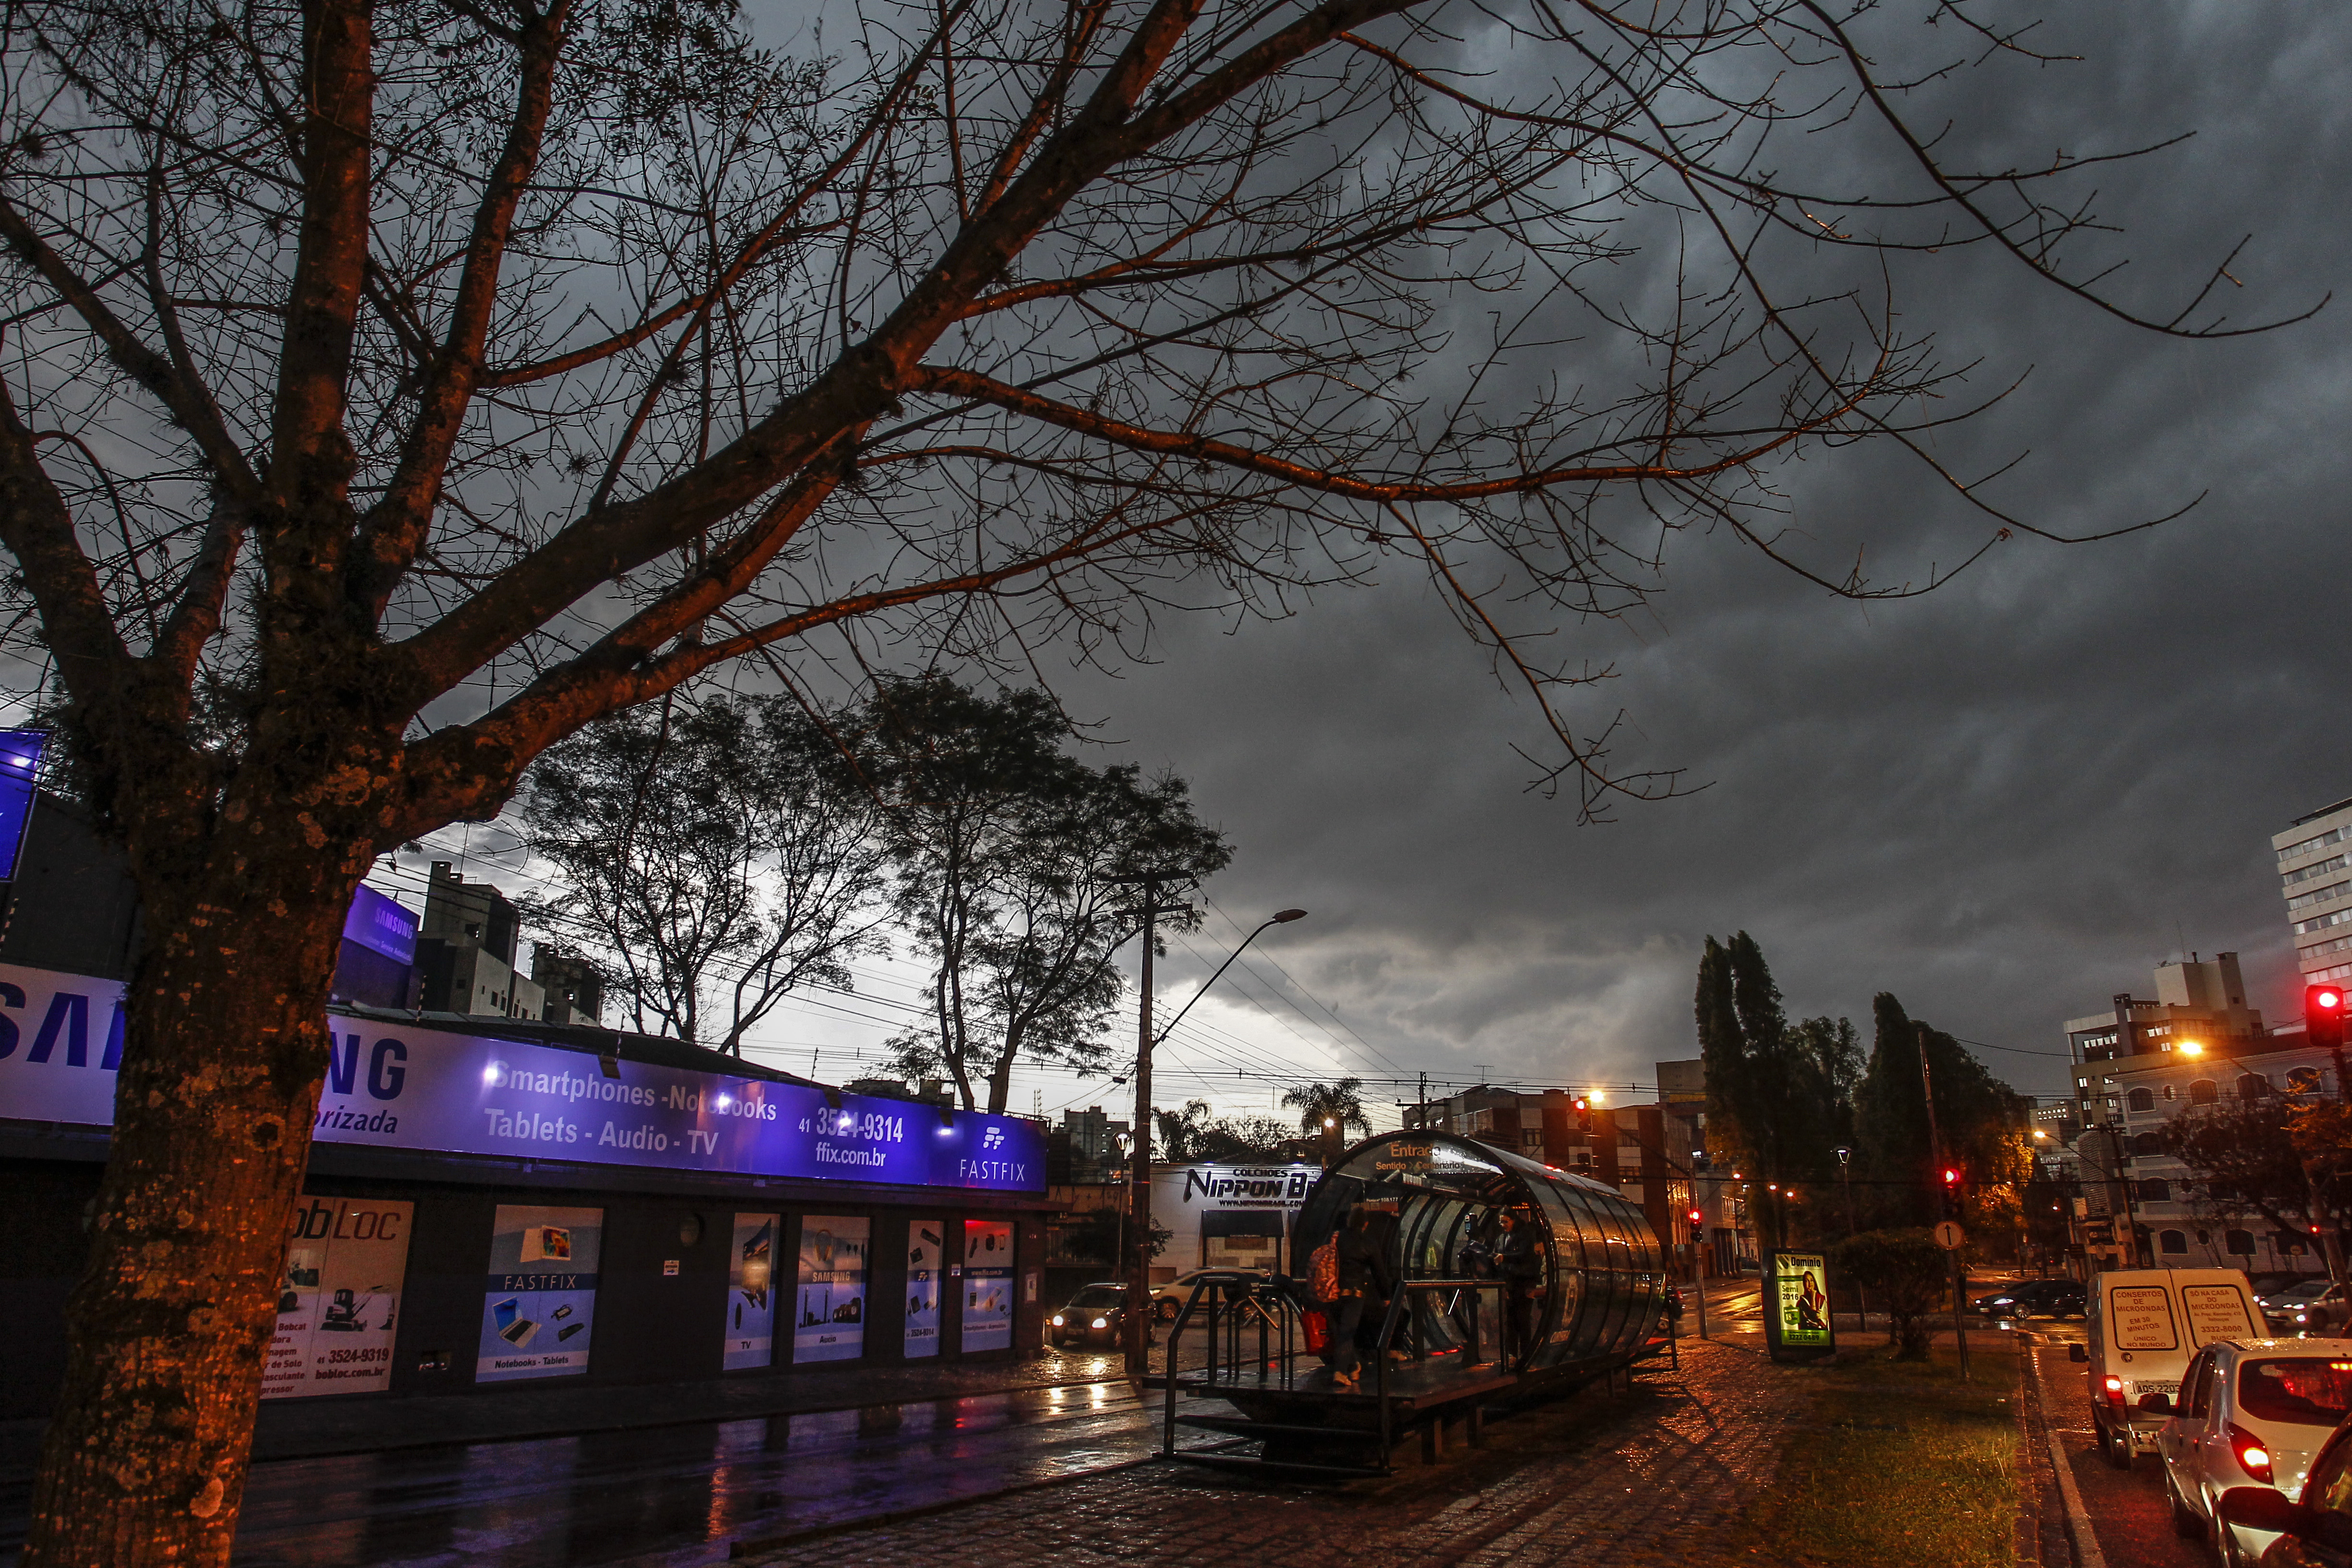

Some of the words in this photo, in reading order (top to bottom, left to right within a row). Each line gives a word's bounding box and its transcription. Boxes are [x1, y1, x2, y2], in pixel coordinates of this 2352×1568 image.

[375, 907, 414, 940] SAMSUNG
[488, 1060, 655, 1106] Smartphones
[314, 1105, 398, 1134] rizada
[798, 1118, 810, 1133] 41
[817, 1107, 903, 1143] 3524-9314
[484, 1108, 577, 1143] Tablets
[598, 1121, 668, 1152] Audio
[687, 1129, 719, 1155] TV
[816, 1142, 886, 1167] ffix.com.br
[1390, 1143, 1441, 1157] Entrada
[960, 1159, 1025, 1182] FASTFIX
[1376, 1162, 1406, 1170] Sentido
[1418, 1162, 1460, 1170] Centenário
[1183, 1168, 1284, 1203] NIPPON
[1791, 1256, 1821, 1267] Domínio
[504, 1275, 576, 1290] FASTFIX
[813, 1271, 850, 1282] SAMSUNG
[278, 1323, 306, 1331] Bobcat
[2127, 1323, 2160, 1332] MINUTOS
[741, 1341, 751, 1349] TV
[329, 1348, 389, 1364] 3524-9319
[495, 1358, 536, 1369] Notebooks
[543, 1356, 569, 1365] Tablets
[271, 1360, 282, 1369] de
[316, 1367, 386, 1379] bobloc.com.br
